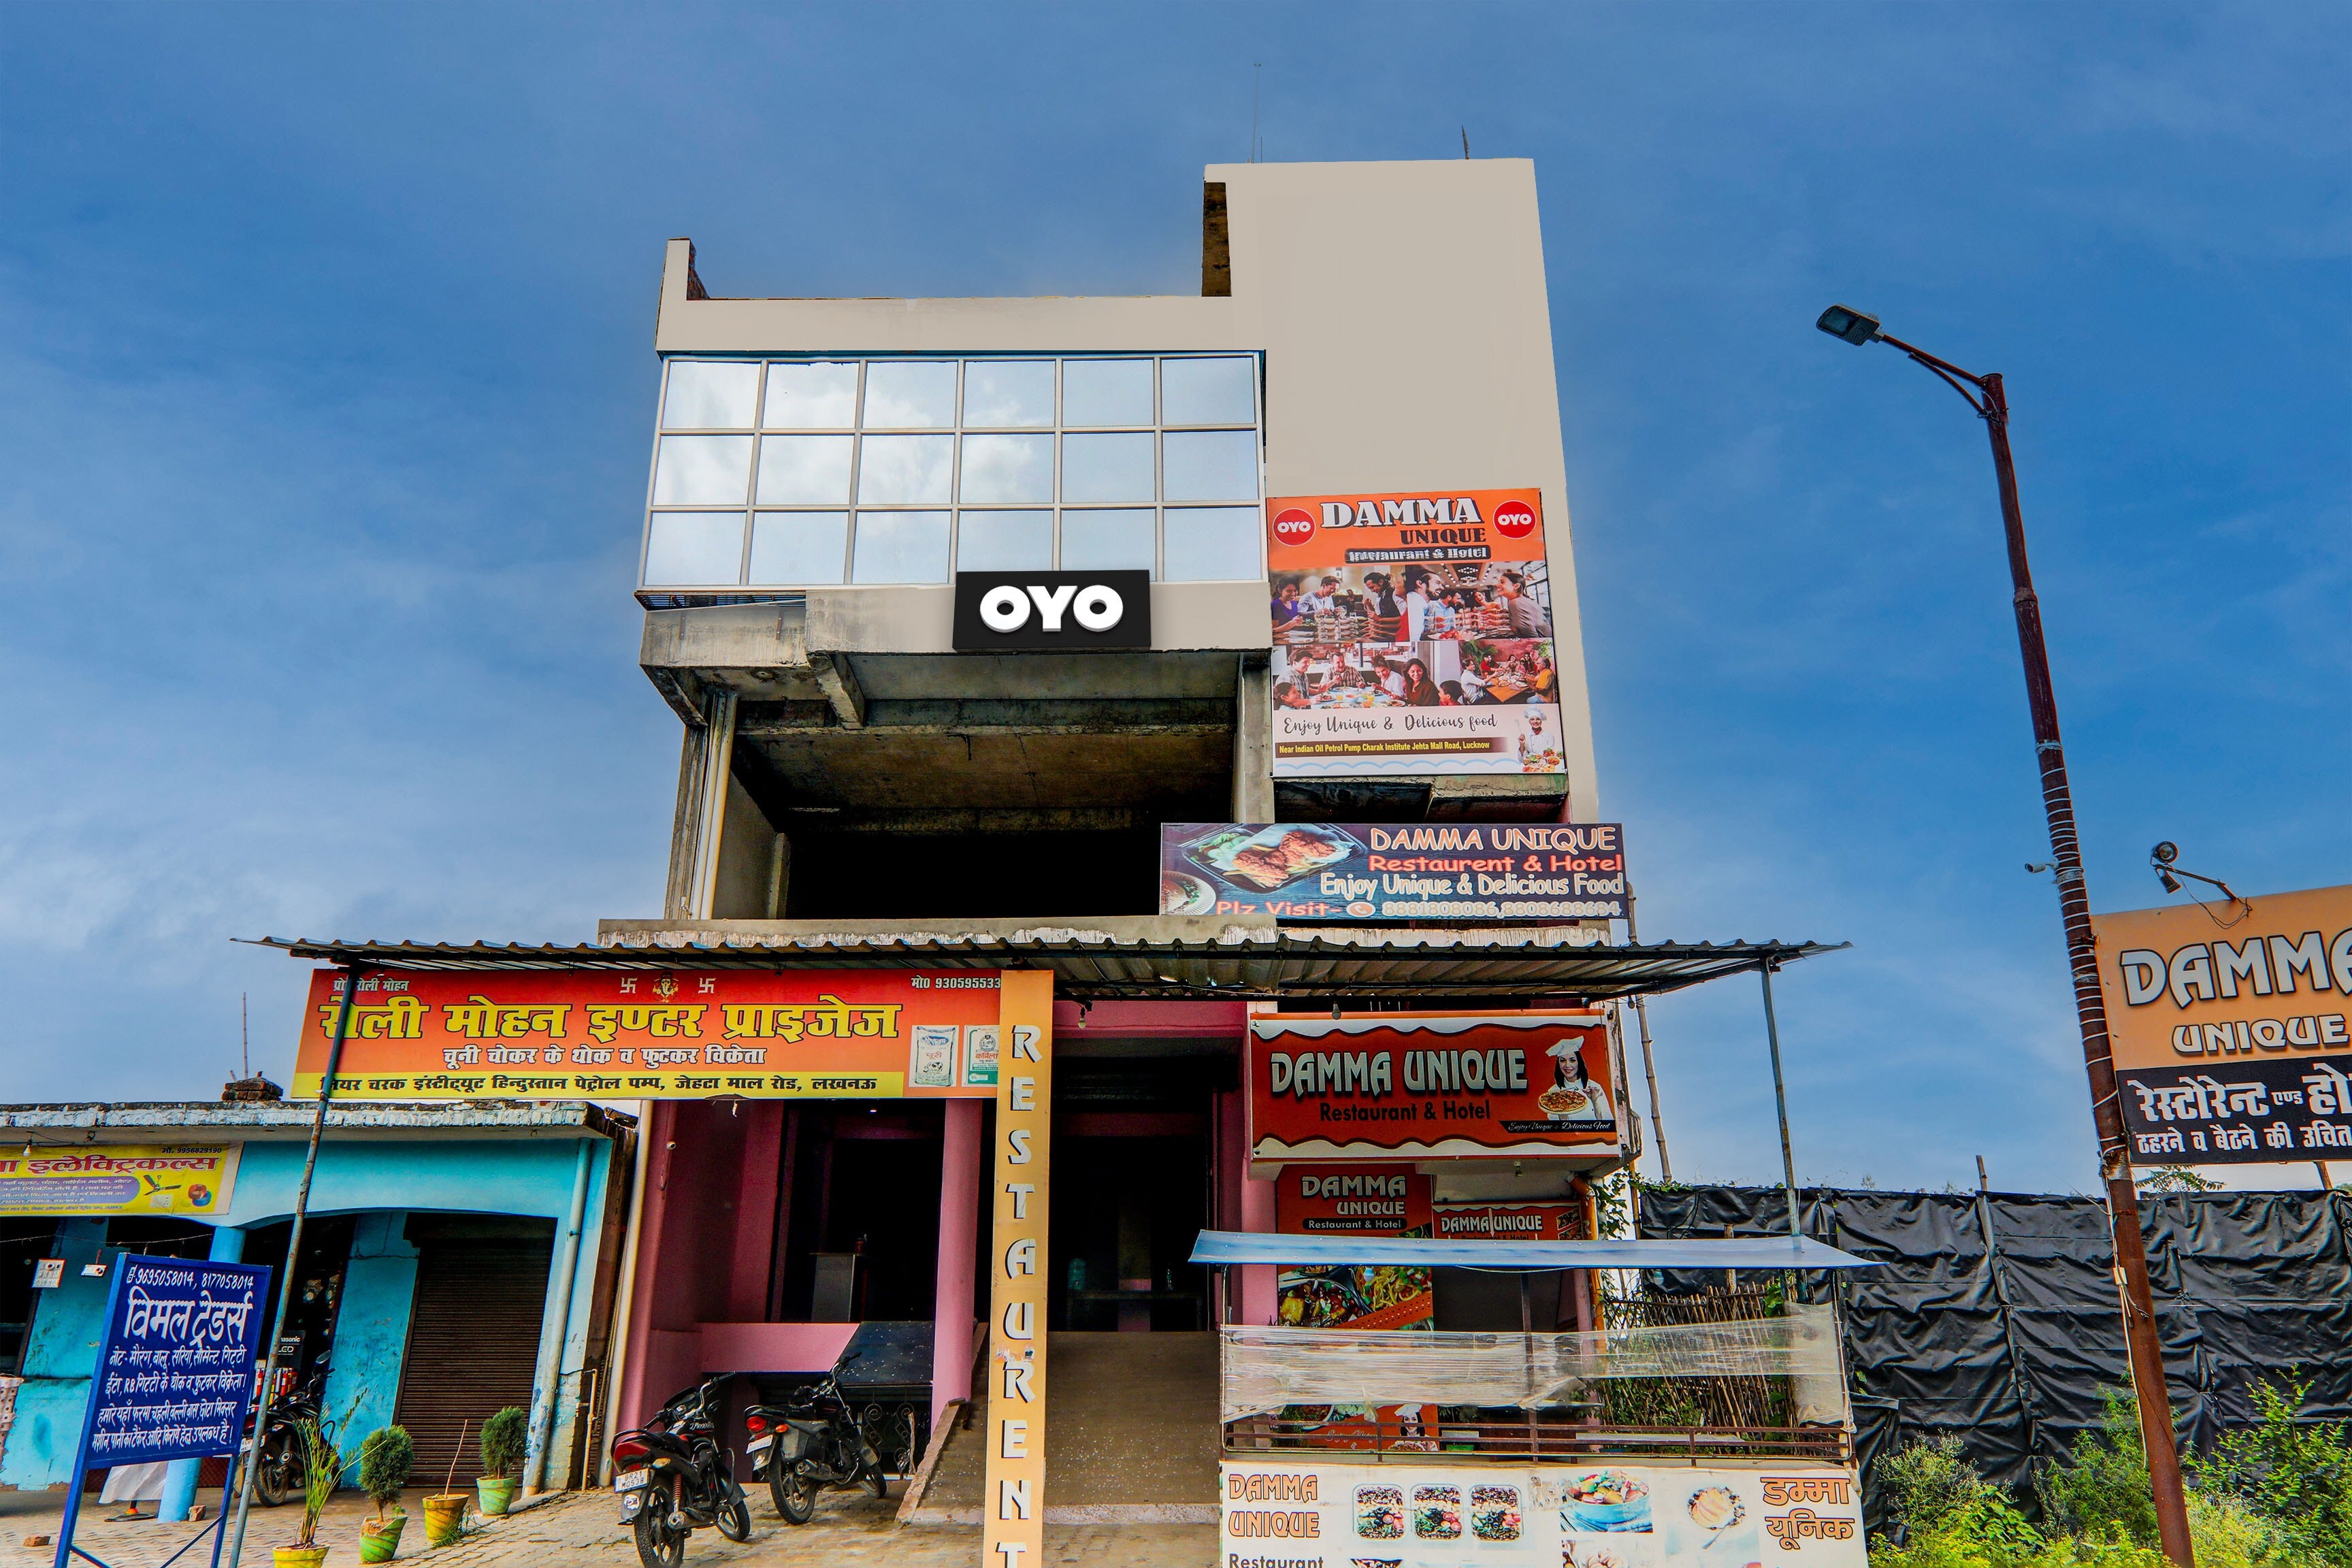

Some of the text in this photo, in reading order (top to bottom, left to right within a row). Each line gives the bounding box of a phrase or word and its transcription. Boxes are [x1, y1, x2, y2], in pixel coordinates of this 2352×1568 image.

[1320, 497, 1484, 528] DAMMA
[1497, 514, 1531, 525] OYO
[1277, 521, 1311, 533] OYO
[1399, 527, 1486, 544] UNIQUE
[1432, 548, 1444, 559] &
[1448, 546, 1487, 559] Hotel
[980, 585, 1123, 632] OYO
[1284, 714, 1498, 736] Enjoy Unique & Delicious food
[1279, 740, 1490, 753] Near Indian Oil Petrol Pump Charak Institute Jehta Mall Road, Lucknow
[1370, 826, 1616, 855] DAMMA UNIQUE
[1369, 854, 1622, 872] Restaurent & Hotel
[1320, 872, 1624, 900] Enjoy Unique & Delicious Food
[1215, 900, 1256, 915] Plz
[357, 978, 380, 992] रोली
[382, 978, 410, 992] मोहन
[935, 977, 1001, 989] 930595533
[442, 994, 572, 1039] मोहन
[586, 1002, 708, 1044] इण्टर
[721, 994, 903, 1044] प्राइजेज
[2172, 1013, 2350, 1054] UNIQUE
[442, 1043, 767, 1070] चूनी चोकर के थोक व फुटकर विक्रेता
[368, 1079, 407, 1090] चरक
[492, 1075, 567, 1093] हिन्दुस्तान
[574, 1075, 621, 1092] पेट्रोल
[627, 1077, 665, 1092] पम्प,
[674, 1075, 721, 1090] जेहटा
[728, 1077, 763, 1090] माल
[771, 1074, 802, 1092] रोड,
[811, 1077, 877, 1090] लखनऊ
[1271, 1048, 1529, 1098] DAMMA UNIQUE
[2127, 1062, 2352, 1122] रेस्टोरेन्ट एण्ड हो
[1320, 1100, 1491, 1122] Restaurant & Hotel
[1508, 1122, 1529, 1131] Enjoy
[1562, 1122, 1592, 1130] Delicious
[1593, 1121, 1610, 1130] Food
[2191, 1130, 2208, 1152] व
[2264, 1120, 2295, 1149] की
[1301, 1175, 1407, 1199] DAMMA
[1336, 1201, 1405, 1215] UNIQUE
[1308, 1219, 1402, 1229] Restaurant & Hotel
[1441, 1215, 1543, 1232] DAMMA UNIQUE
[136, 1268, 255, 1290] 9695058014, 8177058014
[123, 1286, 254, 1348] विमल ट्रेडर्स
[124, 1378, 135, 1393] RB
[161, 1371, 170, 1393] के
[170, 1371, 186, 1393] थोक
[186, 1375, 195, 1392] व
[192, 1374, 218, 1396] फुटकर
[97, 1403, 118, 1428] हमारे
[1228, 1474, 1319, 1503] DAMMA
[1760, 1476, 1850, 1505] डम्मा
[1228, 1511, 1321, 1538] UNIQUE
[1764, 1507, 1855, 1550] यूनिक
[1229, 1553, 1324, 1568] Restaurant
